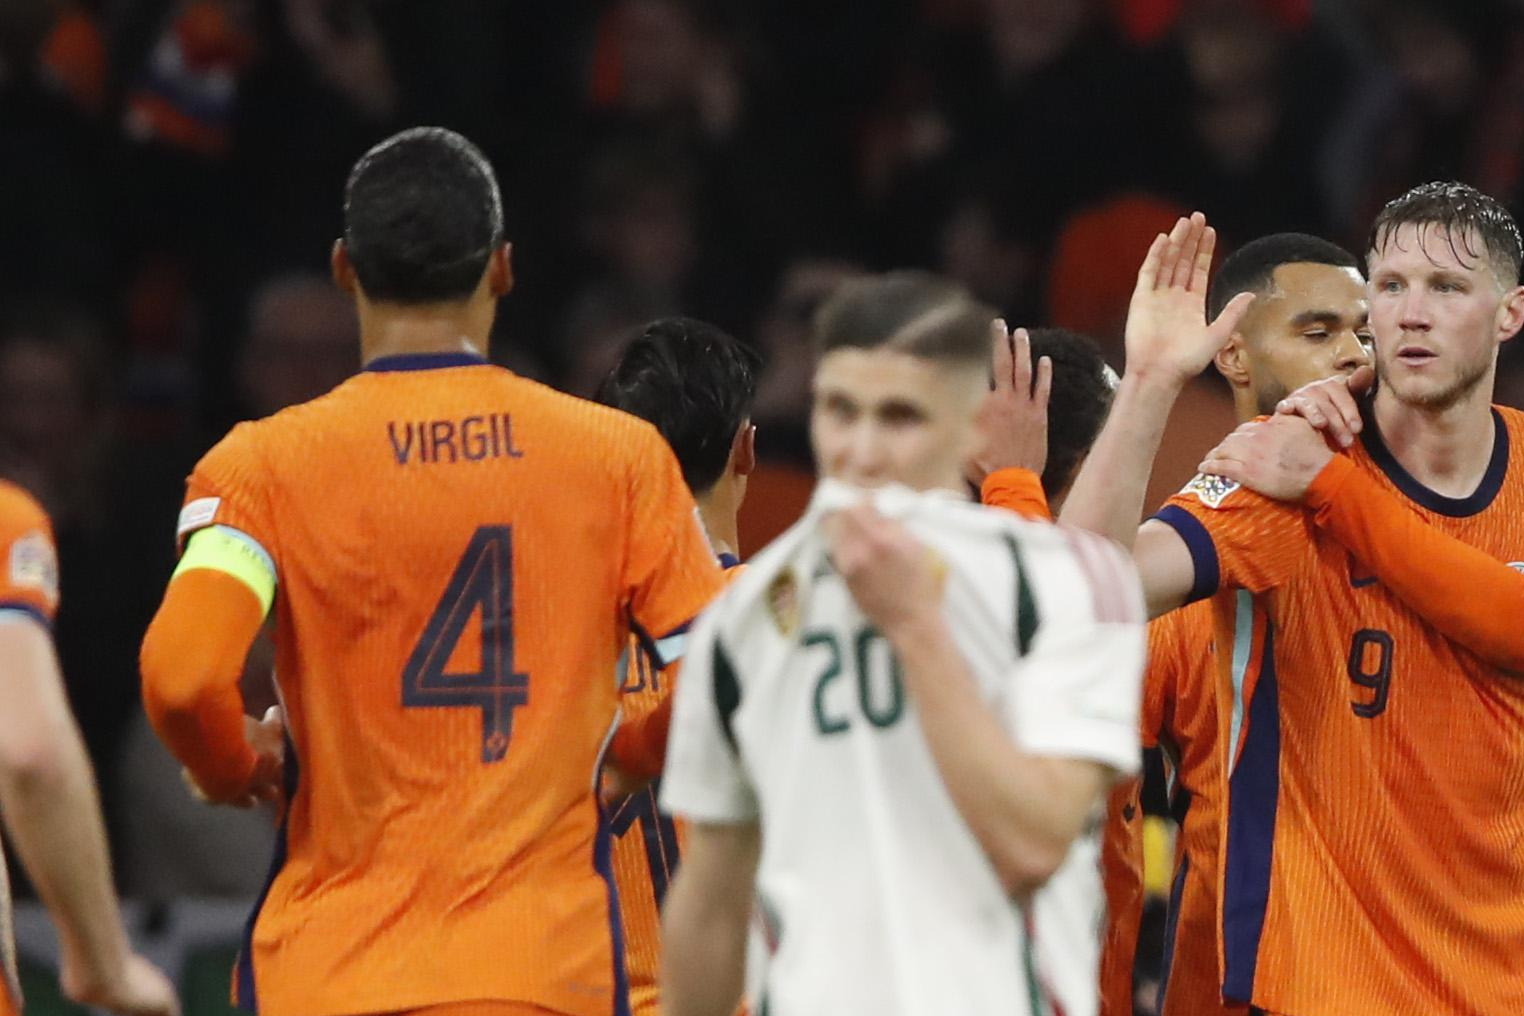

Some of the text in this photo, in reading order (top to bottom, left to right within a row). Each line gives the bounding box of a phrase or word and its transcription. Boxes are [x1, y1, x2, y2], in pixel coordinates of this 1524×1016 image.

[388, 413, 523, 464] VIRGIL
[401, 524, 530, 764] 4
[801, 626, 905, 735] 20
[1347, 628, 1394, 718] 9
